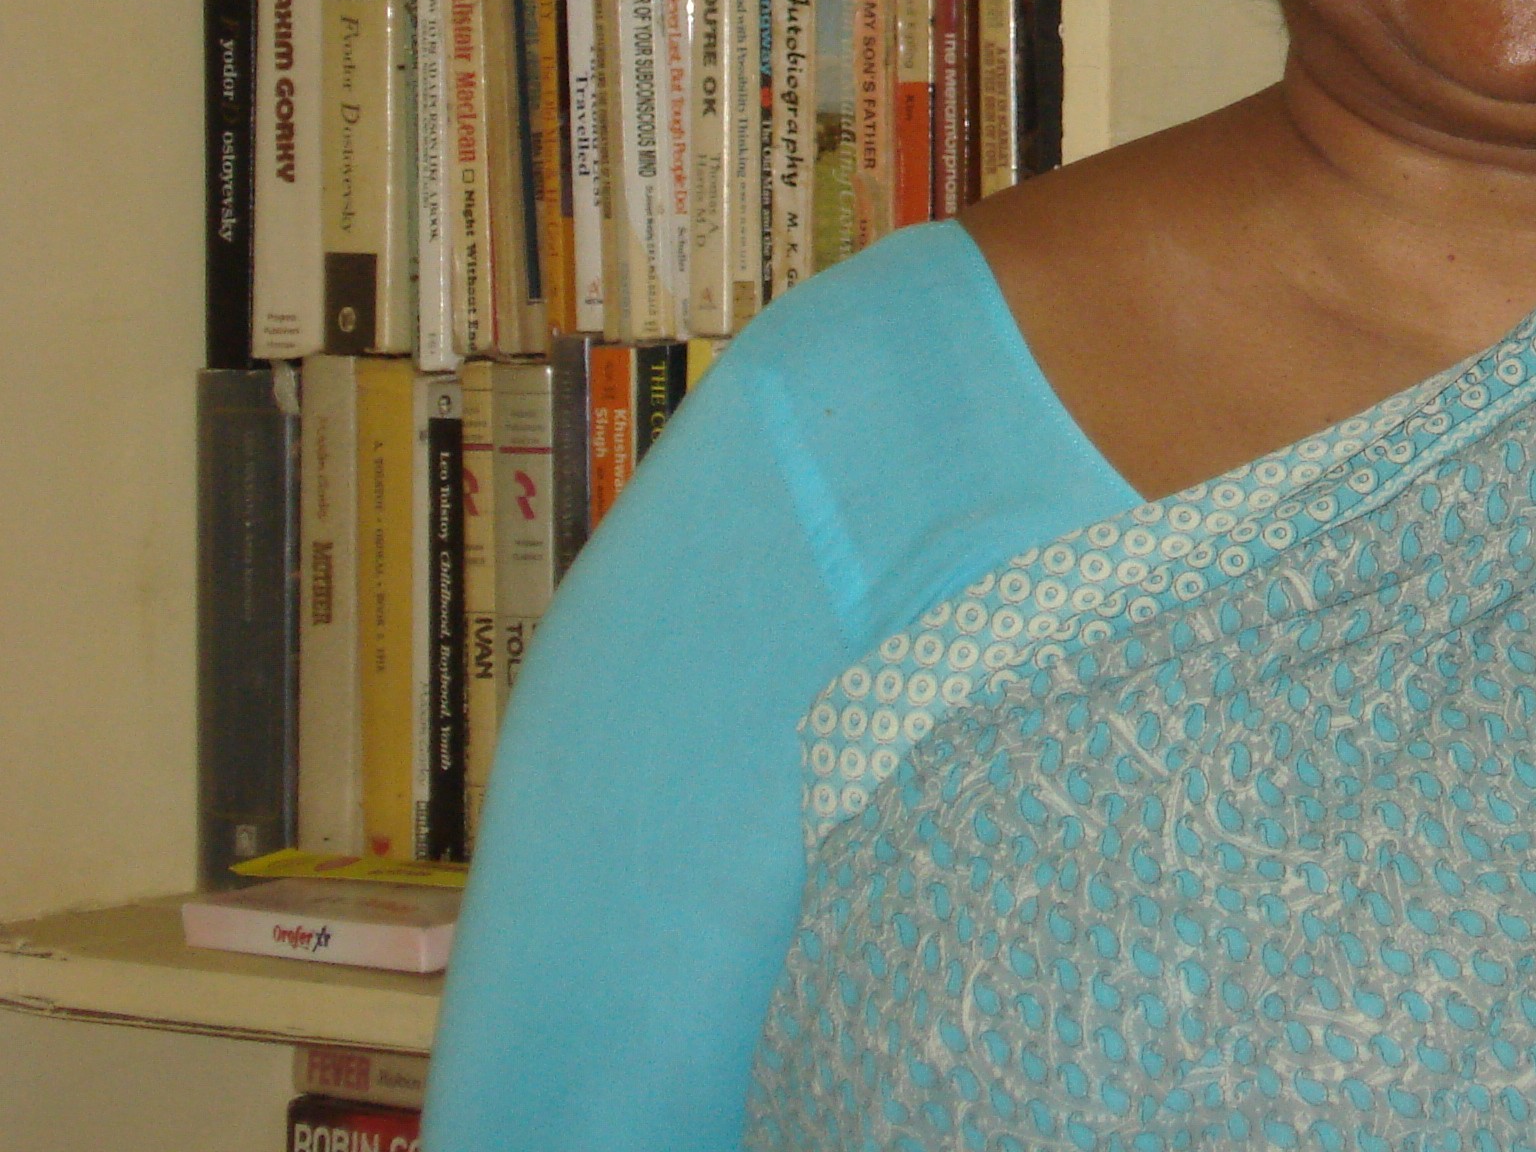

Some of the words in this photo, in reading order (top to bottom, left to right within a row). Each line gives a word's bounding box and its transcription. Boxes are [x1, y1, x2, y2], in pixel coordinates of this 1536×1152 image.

[634, 6, 652, 23] OF
[634, 24, 653, 56] YOUR
[863, 0, 877, 29] MY
[669, 67, 685, 93] But
[862, 34, 877, 93] SON'S
[455, 70, 478, 164] MacLean
[635, 57, 657, 147] SUBCONSCIOUS
[669, 97, 685, 137] Tough
[701, 76, 717, 118] OK
[273, 76, 296, 184] GORKY
[575, 73, 591, 177] Travelled
[736, 116, 749, 179] Thinking
[862, 96, 878, 171] FATHER
[638, 149, 658, 179] MIND
[671, 142, 687, 186] People
[708, 152, 722, 215] Thomas
[462, 188, 476, 238] Night
[649, 359, 667, 408] THE
[593, 406, 609, 459] Singh
[438, 450, 451, 482] Leo
[437, 484, 453, 543] Tolstoy
[311, 540, 336, 627] MOTHER
[438, 549, 453, 641] Childhood,
[474, 617, 494, 680] IVAN
[439, 724, 452, 771] Youth
[294, 1122, 381, 1152] ROBIN
